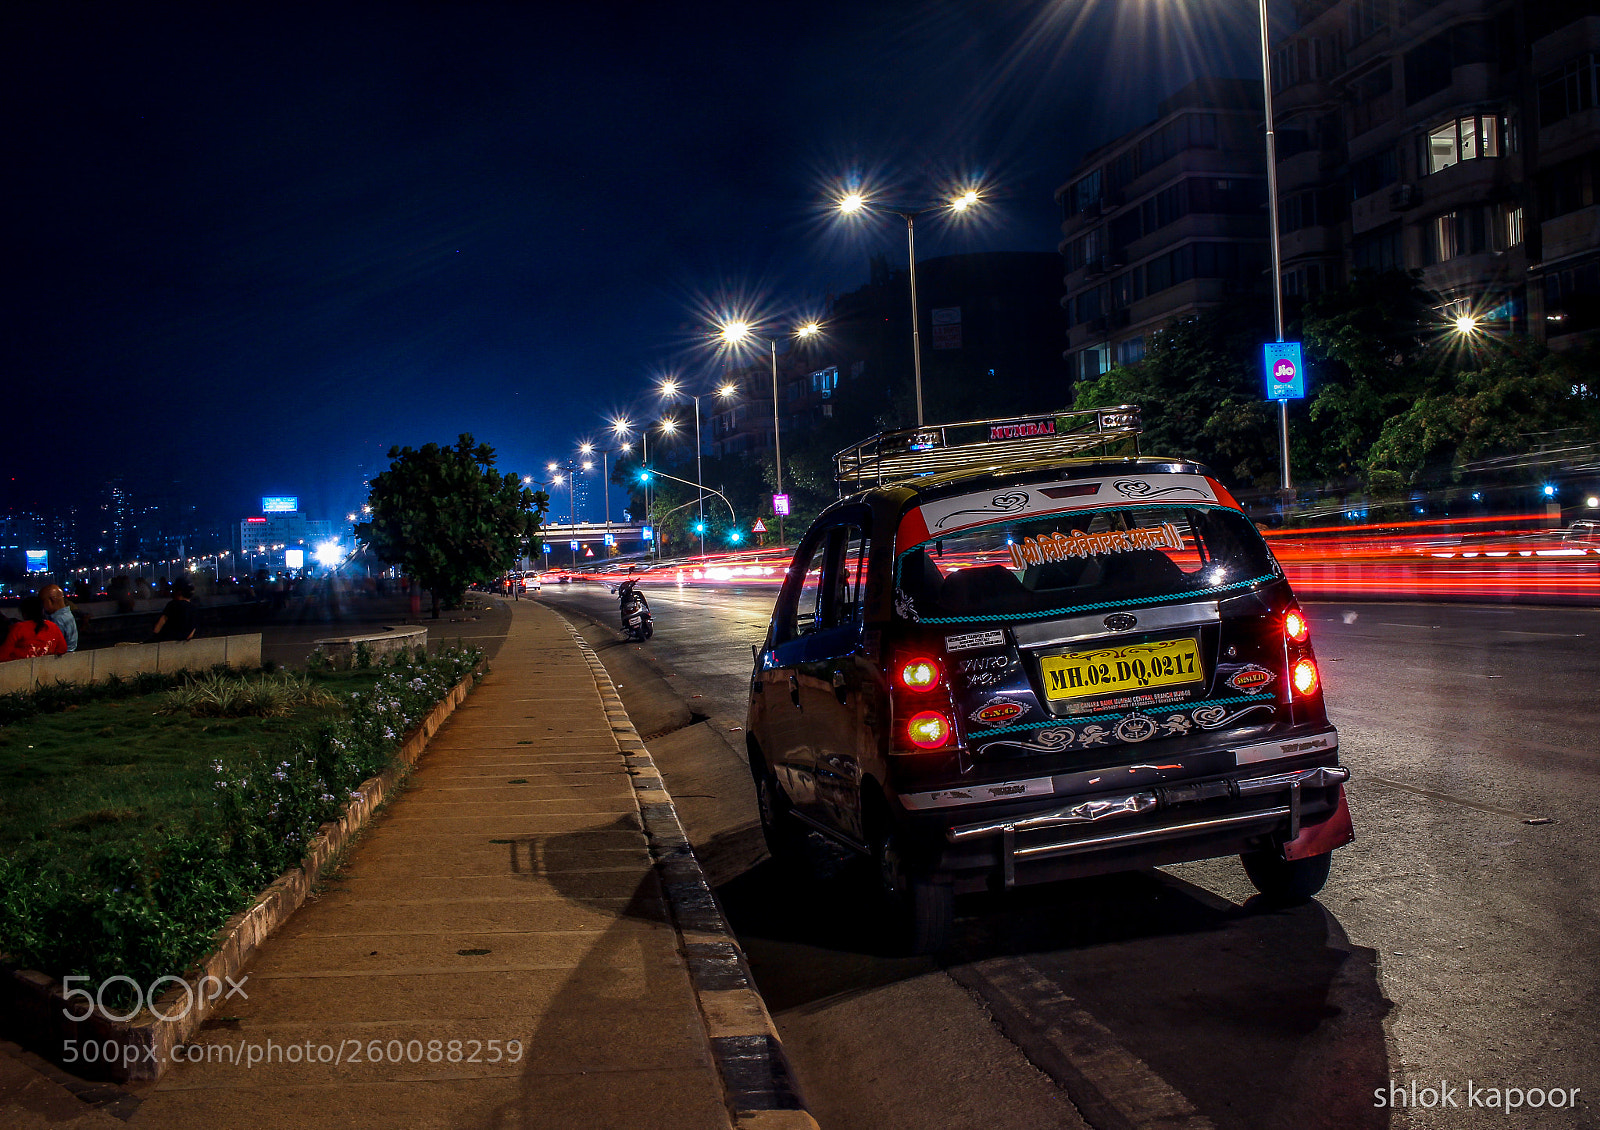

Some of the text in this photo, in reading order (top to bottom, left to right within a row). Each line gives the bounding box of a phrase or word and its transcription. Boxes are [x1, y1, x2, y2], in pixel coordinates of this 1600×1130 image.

[1275, 364, 1294, 377] Jio
[990, 421, 1056, 440] MUMBAI
[1049, 652, 1195, 691] MH.02.DQ.0217
[981, 707, 1018, 719] C.N.G.
